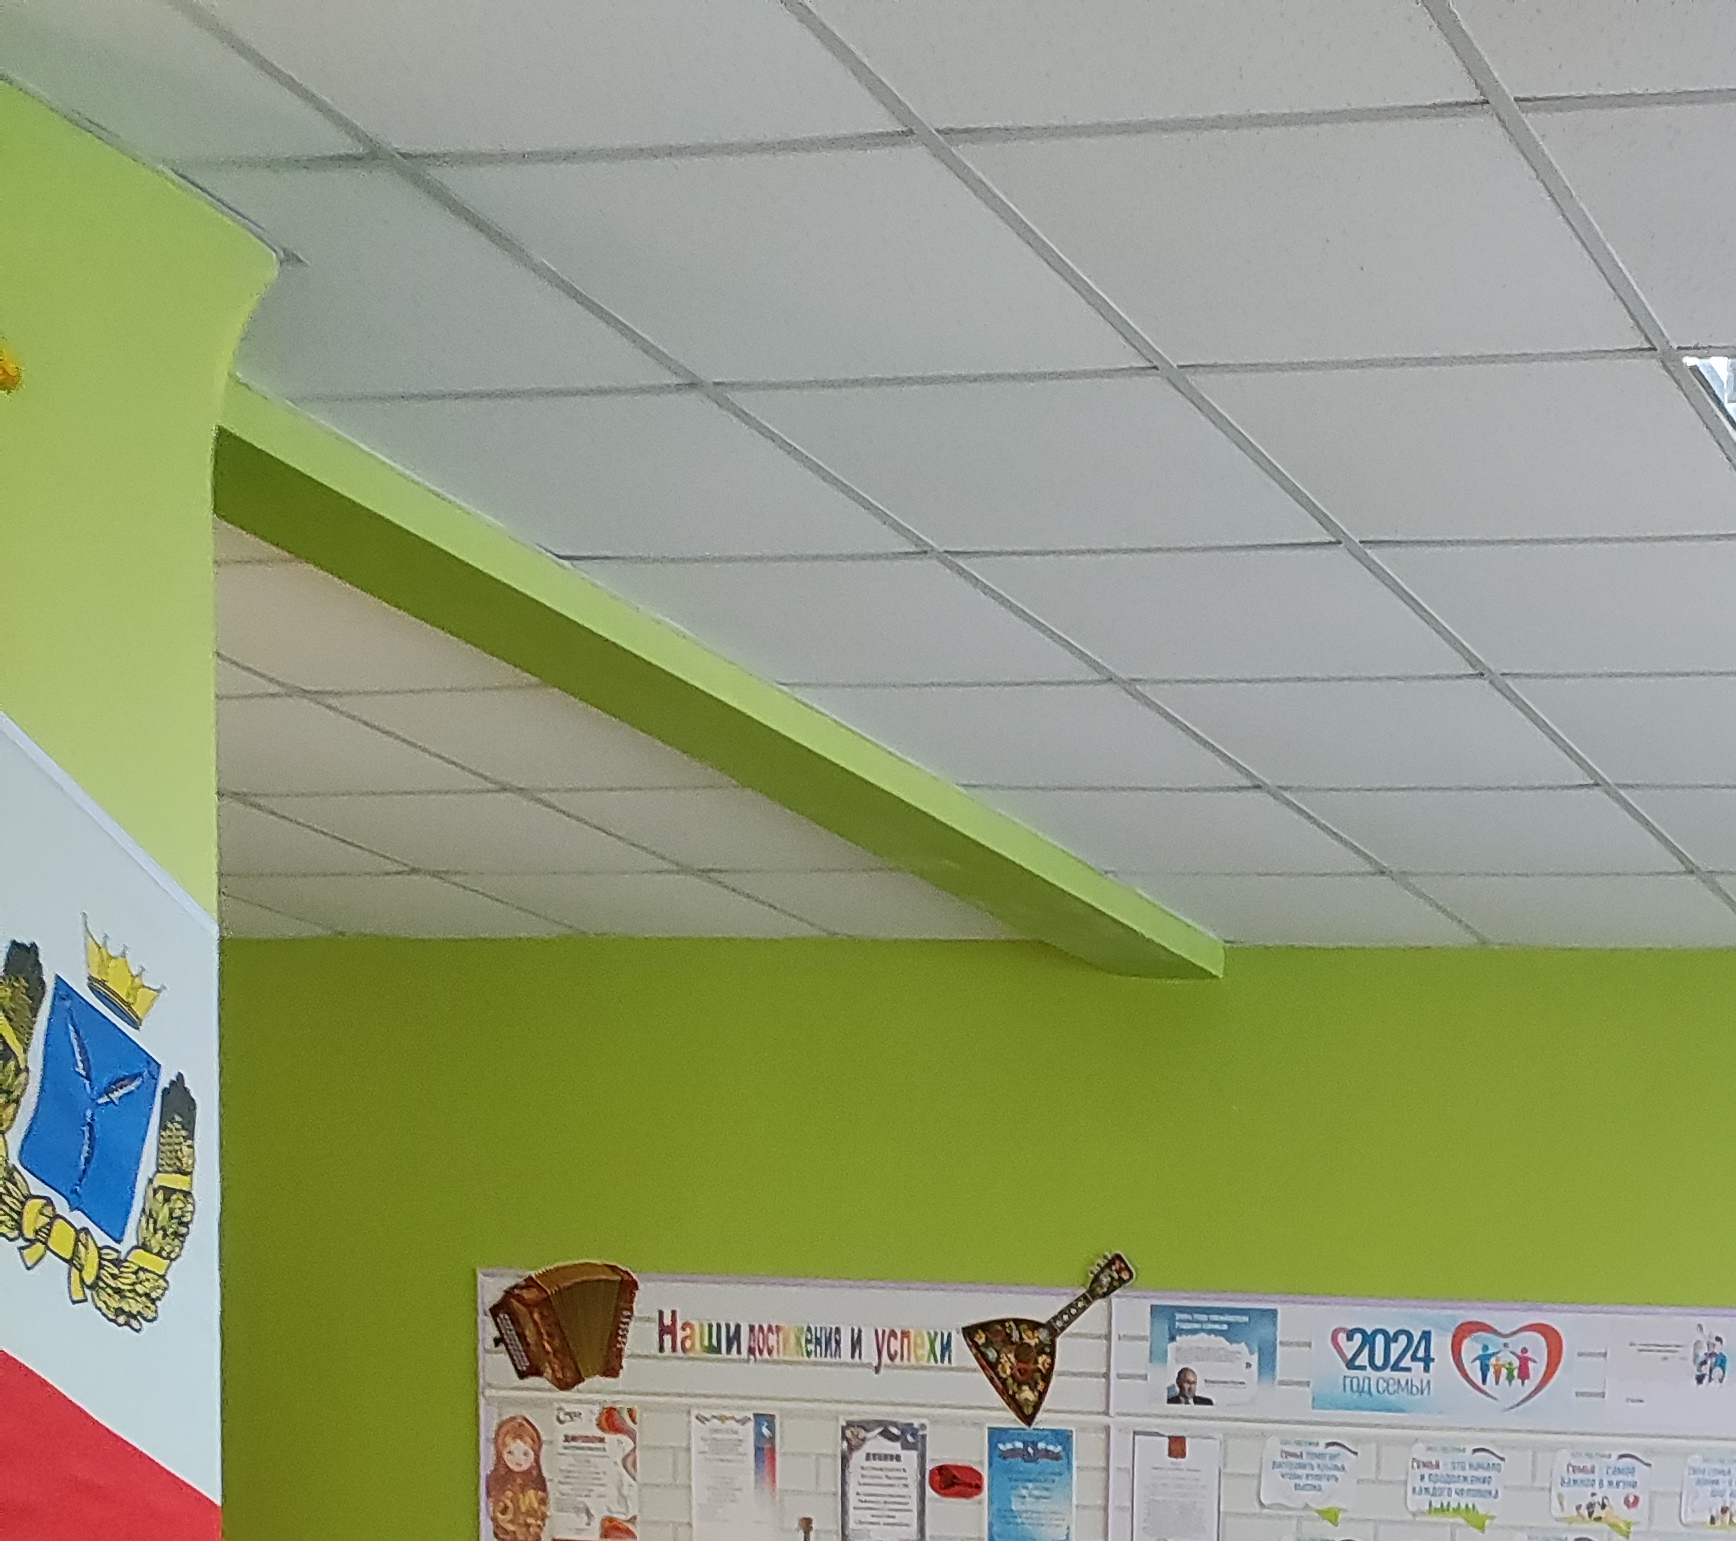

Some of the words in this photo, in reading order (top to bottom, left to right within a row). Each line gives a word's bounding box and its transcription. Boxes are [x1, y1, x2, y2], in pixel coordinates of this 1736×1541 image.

[657, 1309, 742, 1354] Наши
[748, 1323, 842, 1362] достижения
[850, 1327, 862, 1360] и
[874, 1328, 952, 1374] успехи
[1347, 1328, 1435, 1373] 2024
[1342, 1375, 1372, 1396] ГОД
